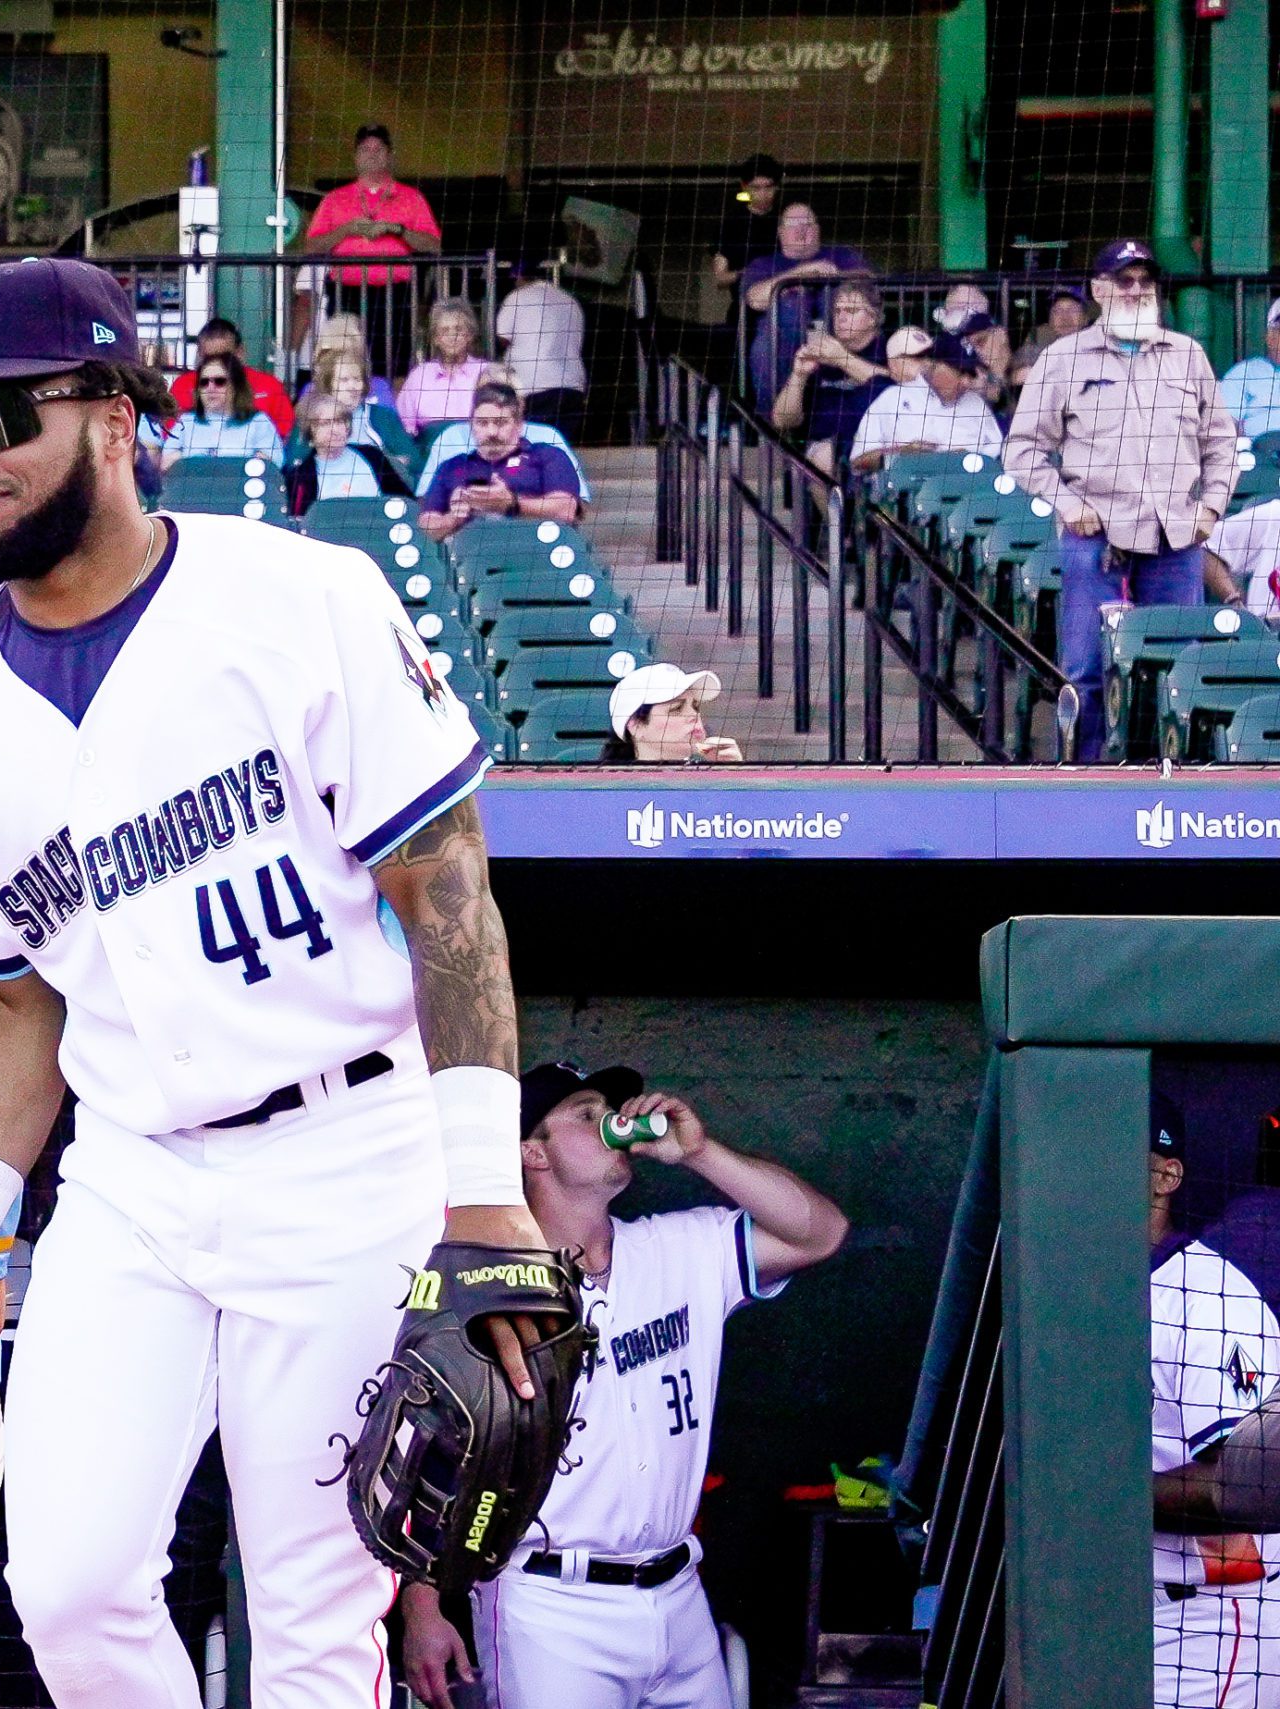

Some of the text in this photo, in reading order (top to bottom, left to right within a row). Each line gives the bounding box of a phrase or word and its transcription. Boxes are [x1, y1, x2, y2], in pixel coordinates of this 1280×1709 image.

[81, 748, 287, 912] COWBOYS
[194, 853, 334, 986] 44
[610, 1303, 690, 1377] COWBOY
[661, 1368, 699, 1437] 32
[464, 1490, 497, 1552] A2000
